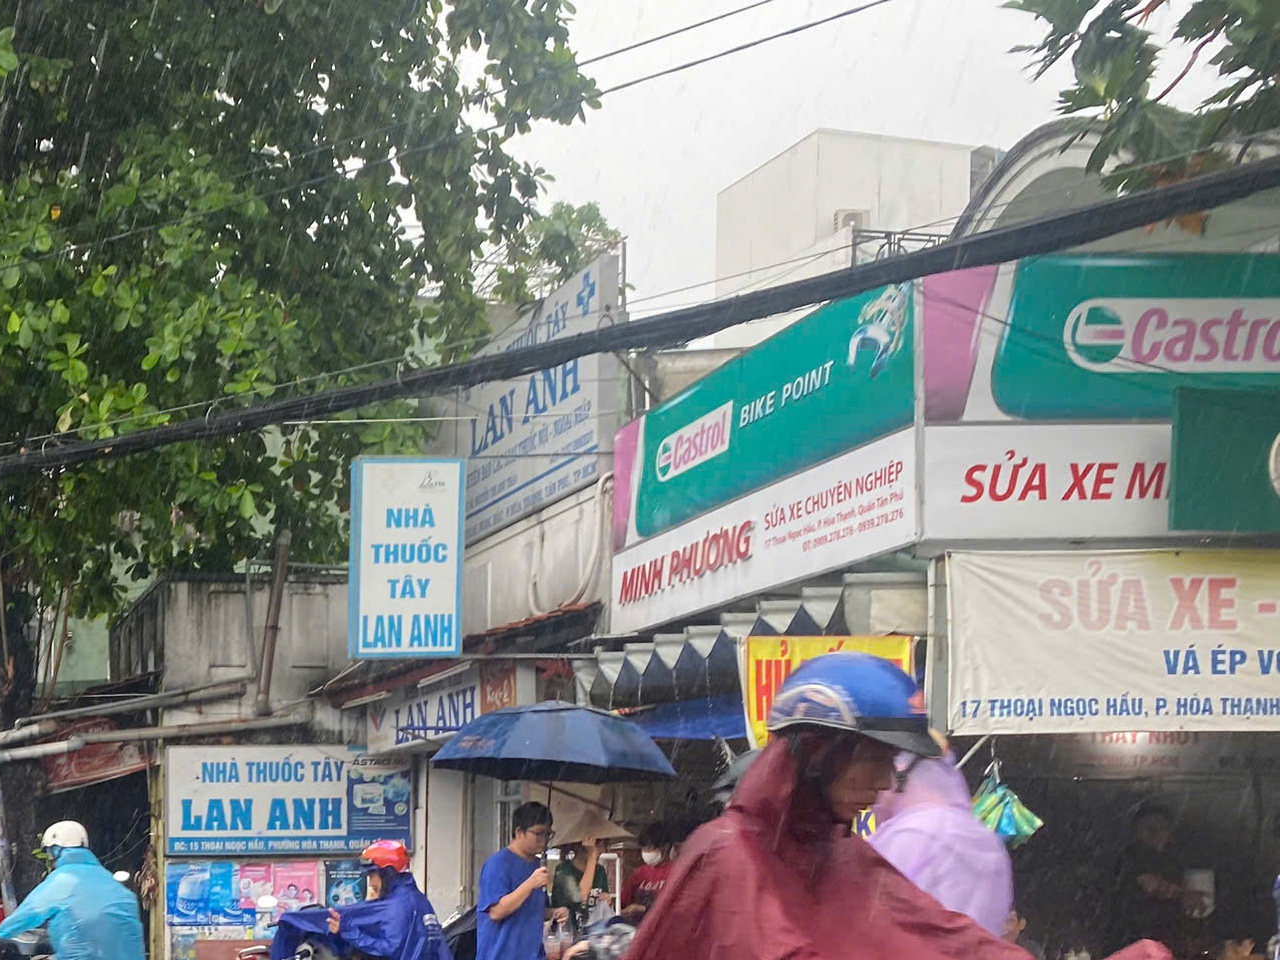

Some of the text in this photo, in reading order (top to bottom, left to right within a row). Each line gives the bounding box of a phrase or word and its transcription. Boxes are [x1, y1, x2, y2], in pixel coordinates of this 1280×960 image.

[470, 387, 516, 457] LAN
[522, 357, 581, 426] ANH
[673, 360, 835, 471] Castrol BIKE POINT
[961, 449, 1170, 503] SỬA XE M
[764, 460, 904, 531] SỬA XE CHUYÊN NGHIỆP
[386, 503, 436, 529] NHÀ
[371, 536, 448, 564] THUỐC
[619, 520, 754, 606] MINH PHƯƠNG
[387, 574, 431, 599] TÂY
[1037, 559, 1152, 632] SỬA
[1168, 577, 1239, 631] XE
[362, 613, 453, 649] LAN ANH
[1163, 643, 1280, 675] VÁ ÉP V
[394, 699, 428, 746] LAN
[434, 685, 476, 736] ANH
[961, 691, 1280, 721] 17 THOẠI NGỌC HẦU, P. HÒA THẠNH
[201, 753, 345, 783] NHÀ THUỐC TÂY
[180, 797, 343, 832] LAN ANH
[190, 841, 199, 851] 15
[201, 841, 223, 852] THOẠI
[224, 841, 247, 852] NGỌC
